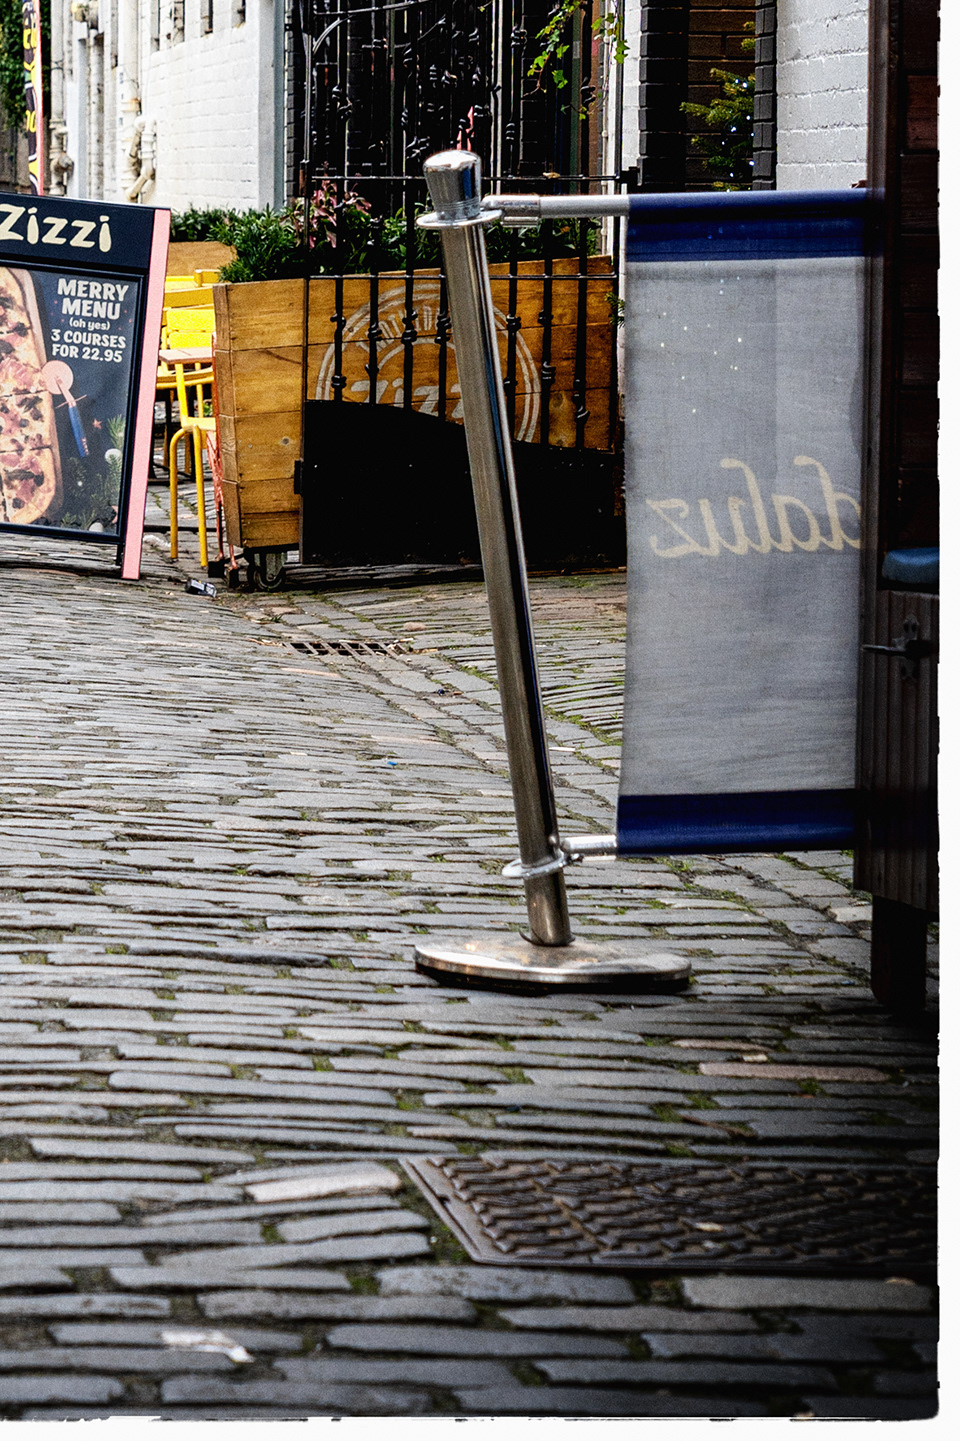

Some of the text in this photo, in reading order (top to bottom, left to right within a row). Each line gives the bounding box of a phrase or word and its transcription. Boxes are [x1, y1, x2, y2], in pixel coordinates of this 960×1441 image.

[57, 277, 129, 302] MERRY
[61, 297, 121, 320] MENU
[68, 316, 111, 331] (oh yes)
[50, 328, 127, 349] 3 COURSES
[51, 343, 123, 363] FOR 22.95
